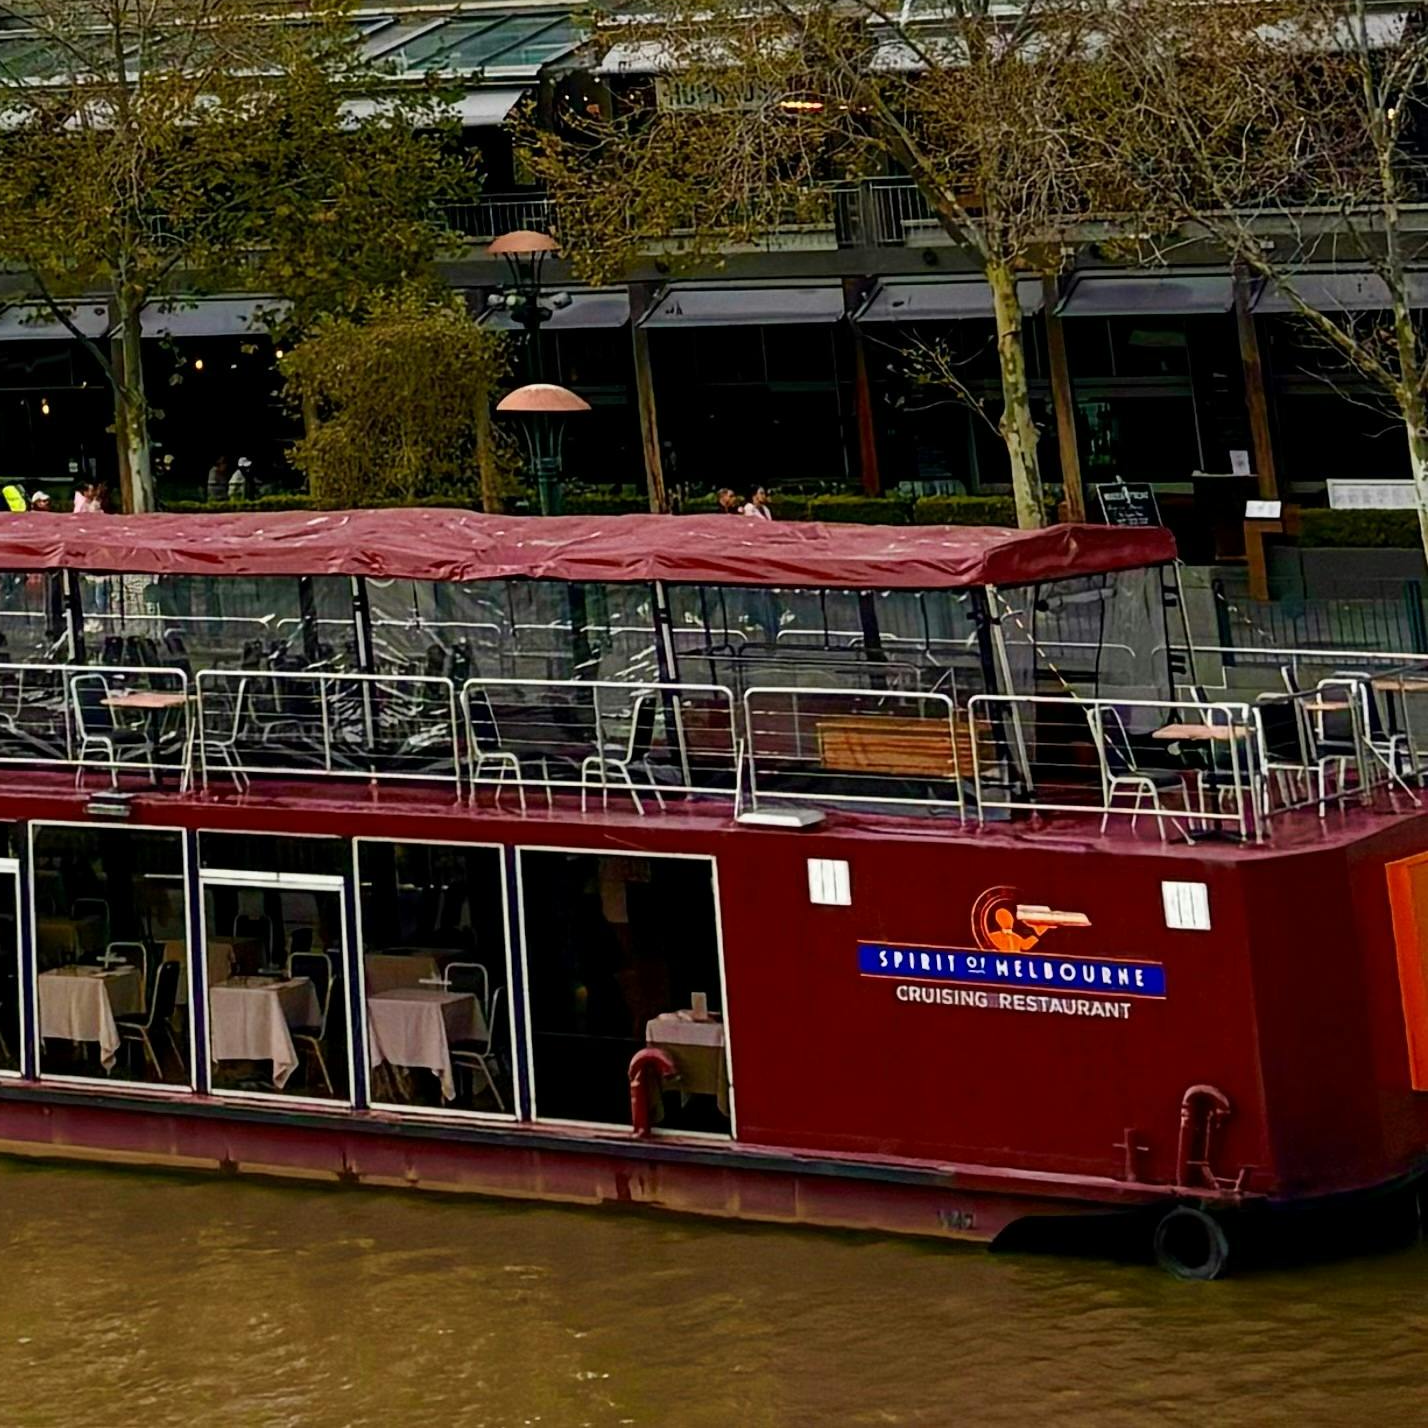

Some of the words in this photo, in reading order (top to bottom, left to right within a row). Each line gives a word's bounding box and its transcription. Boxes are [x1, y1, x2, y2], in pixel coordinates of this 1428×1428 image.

[879, 950, 955, 973] SPIRIT
[996, 959, 1145, 987] MELBOURNE
[896, 985, 988, 1009] CRUISING
[999, 992, 1132, 1019] RESTAURANT
